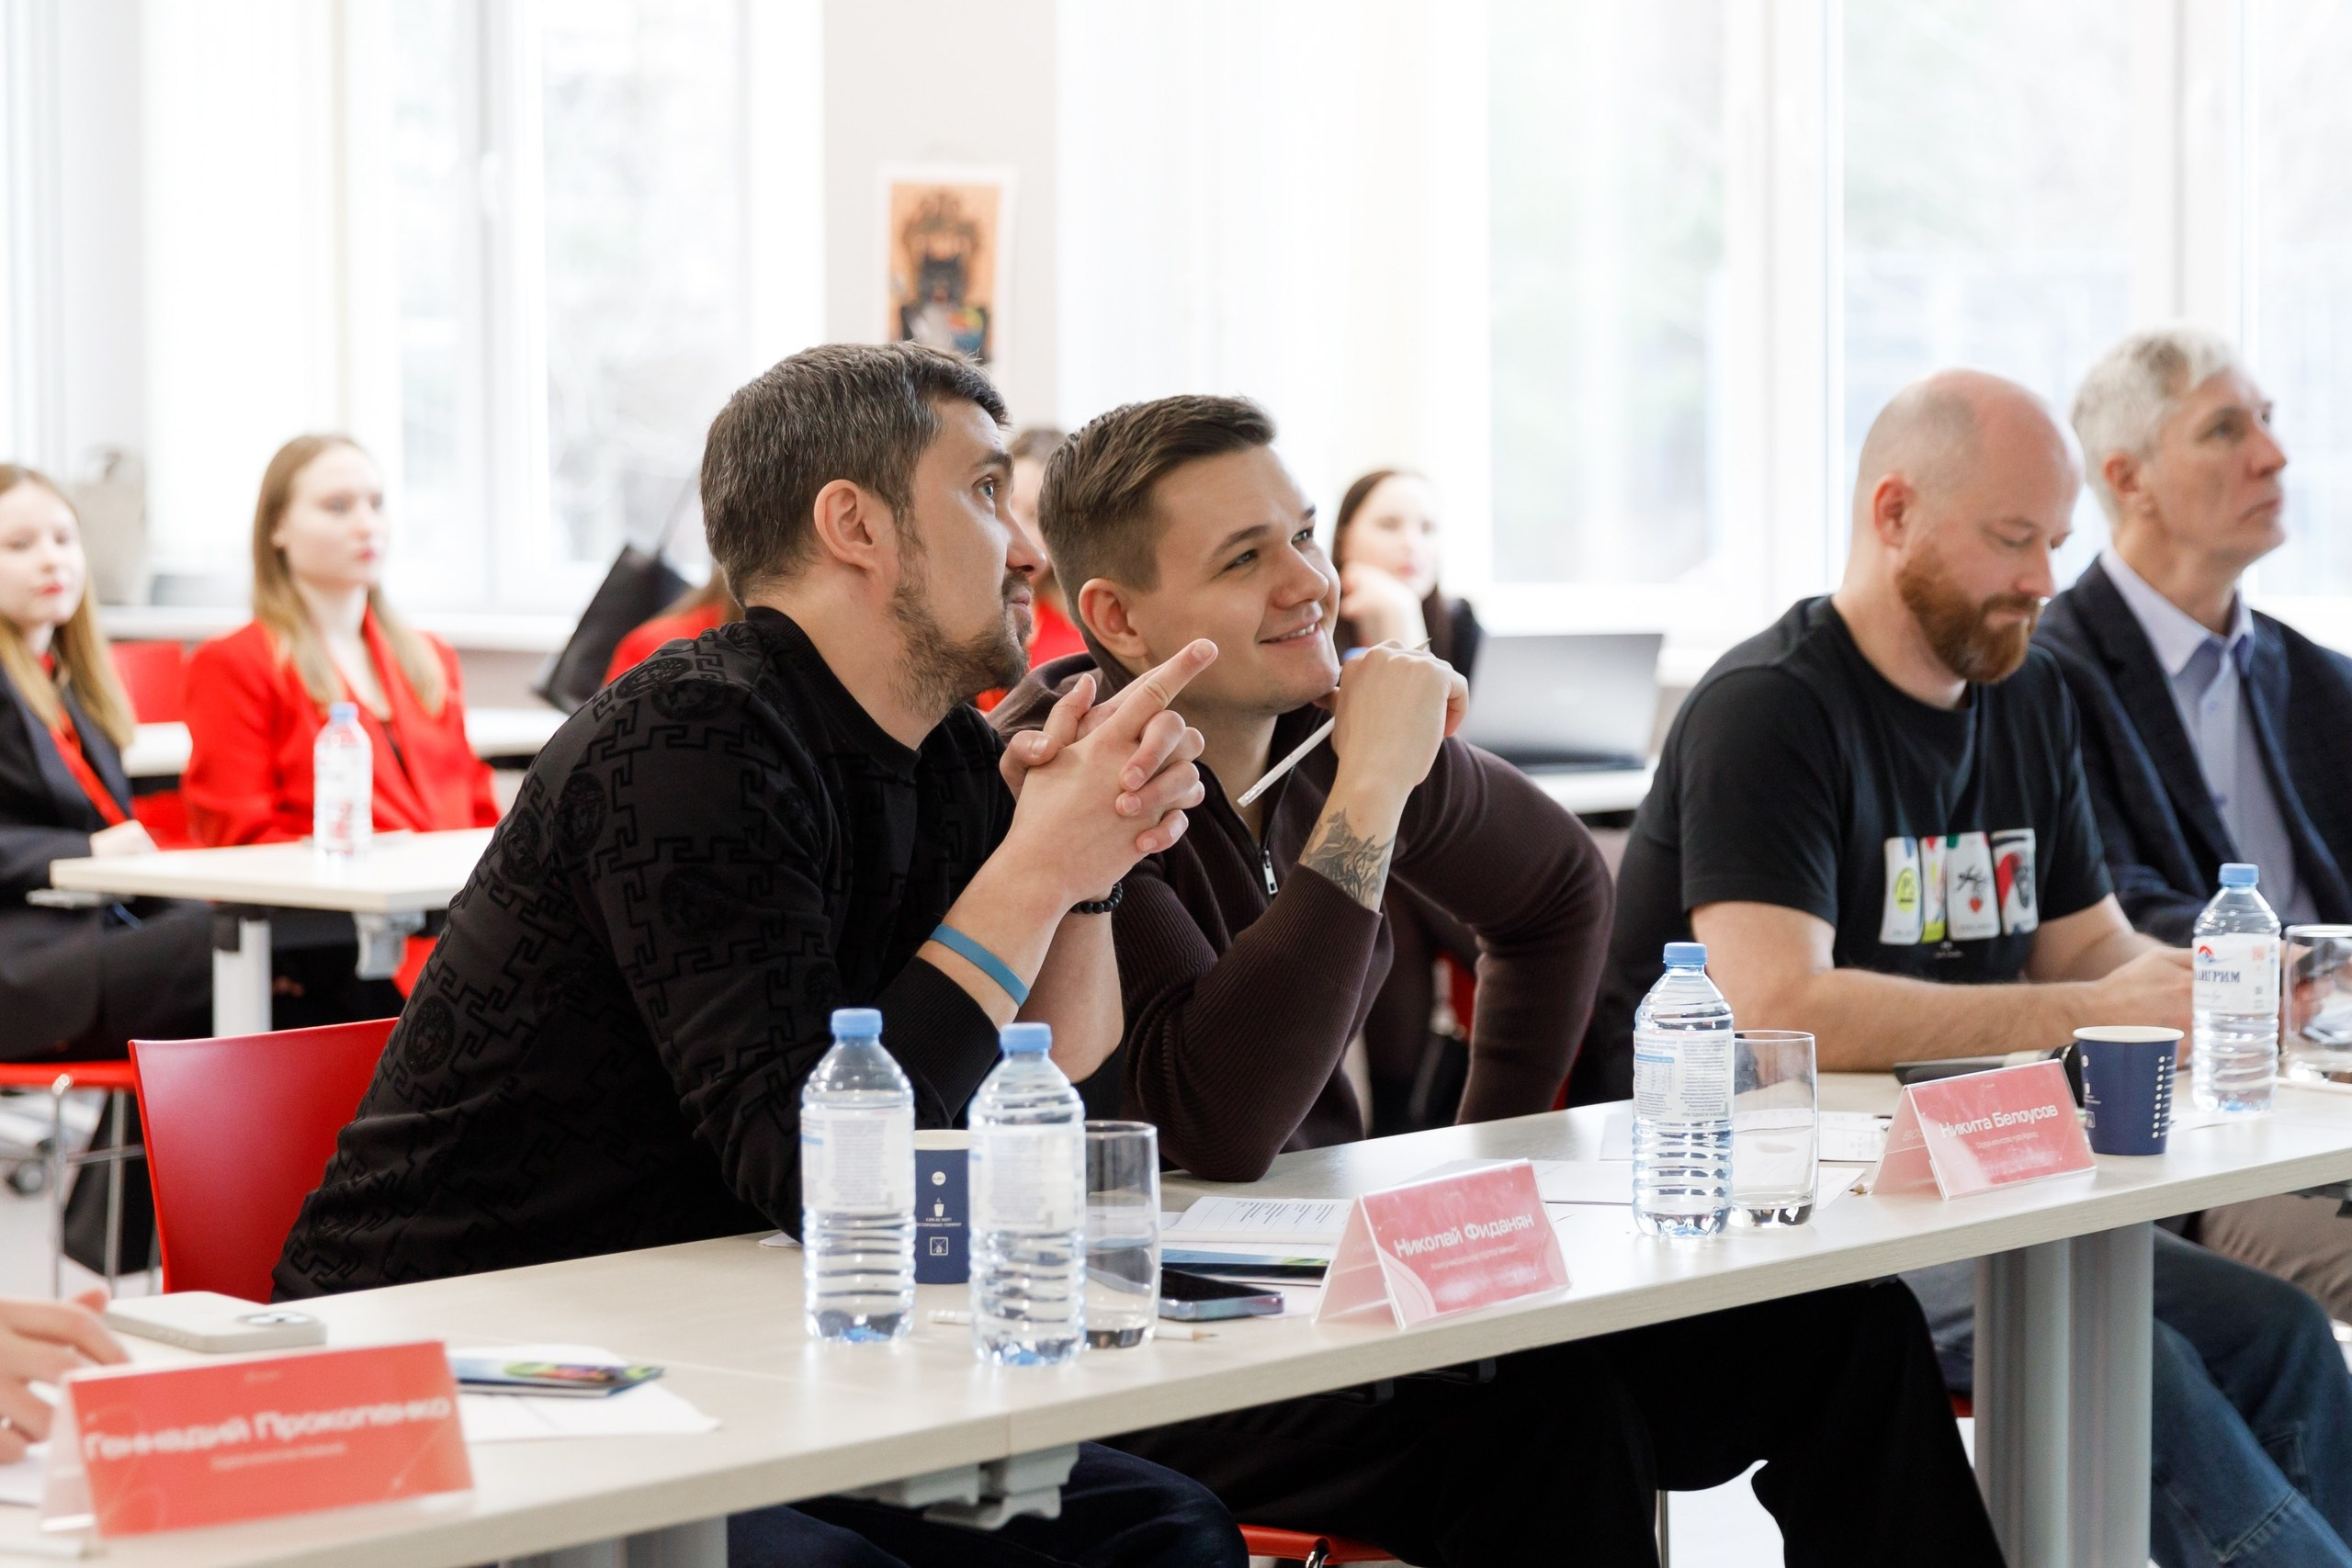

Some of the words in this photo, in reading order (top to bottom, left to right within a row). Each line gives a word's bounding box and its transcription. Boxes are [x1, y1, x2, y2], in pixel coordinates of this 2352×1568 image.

[1939, 1117, 1994, 1138] Никита
[1992, 1104, 2059, 1129] Белоусов
[1393, 1227, 1463, 1258] Николай
[1464, 1213, 1534, 1240] Фиданян
[85, 1416, 251, 1461] Геннадий
[254, 1396, 451, 1441] Прокопенко
